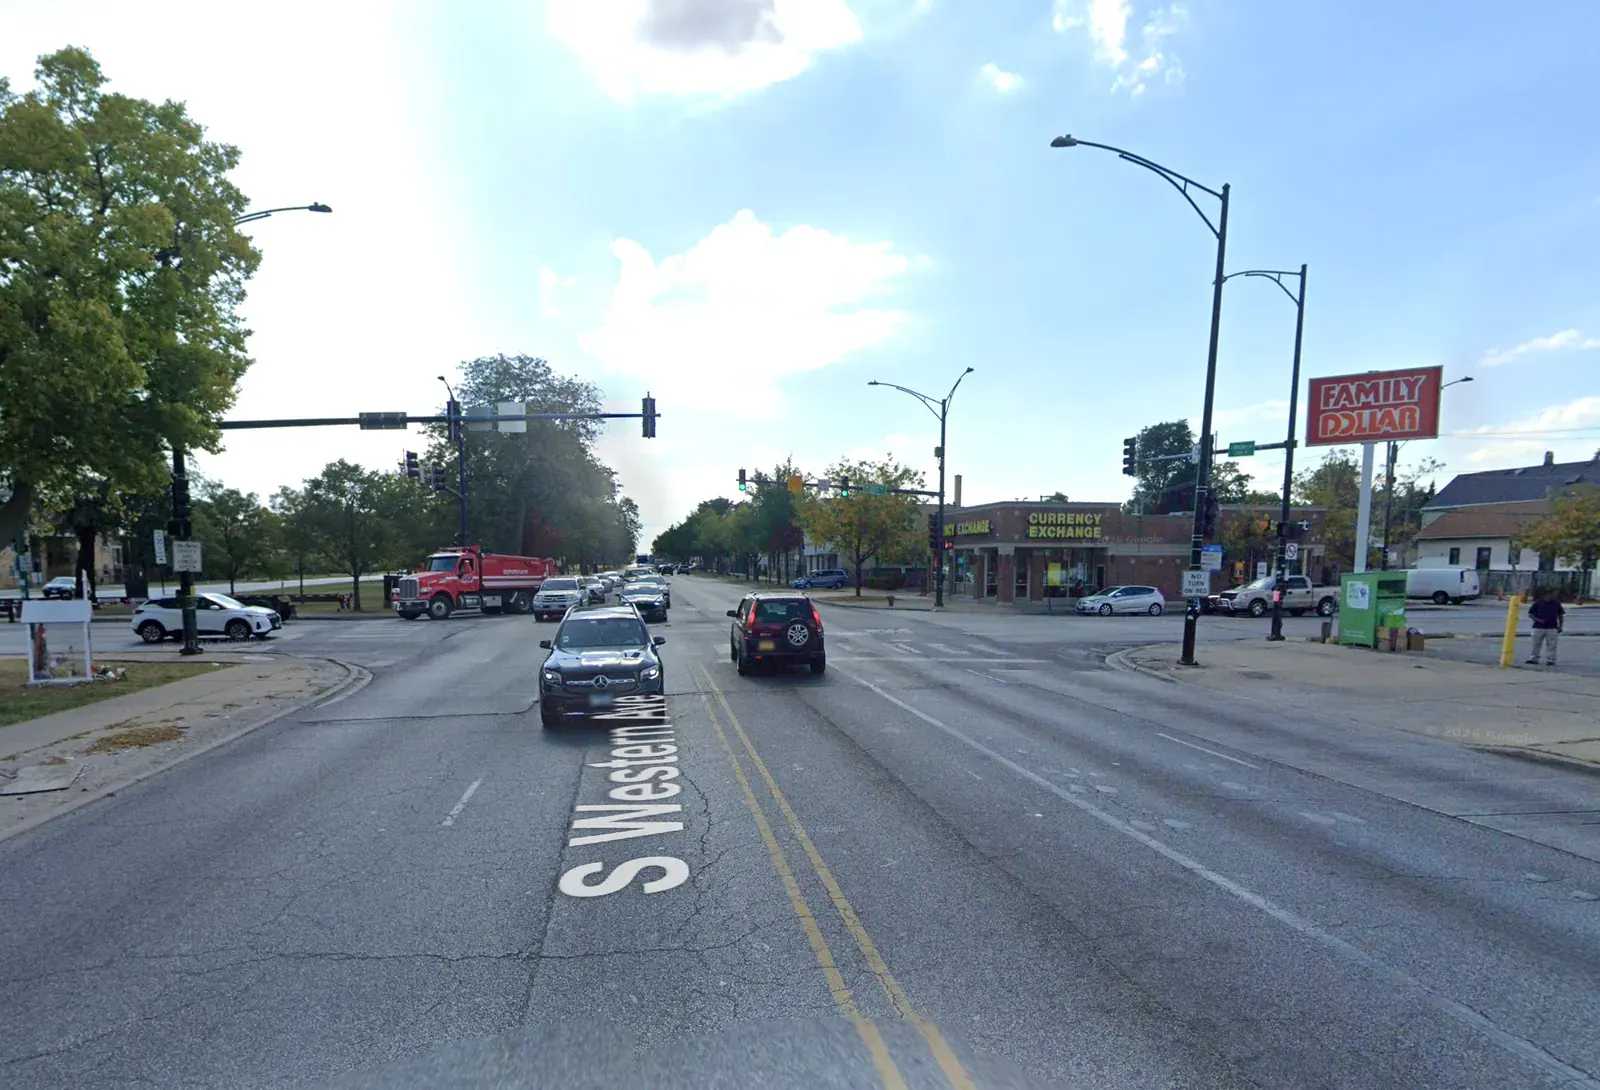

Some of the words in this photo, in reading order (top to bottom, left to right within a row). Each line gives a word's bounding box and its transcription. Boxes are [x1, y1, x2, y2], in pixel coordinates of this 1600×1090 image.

[1321, 375, 1427, 410] FAMILY
[1319, 405, 1420, 438] DOLLAR
[1028, 512, 1102, 525] CURRENCY
[957, 519, 990, 536] EXCHANGE
[1028, 526, 1102, 538] EXCHANGE
